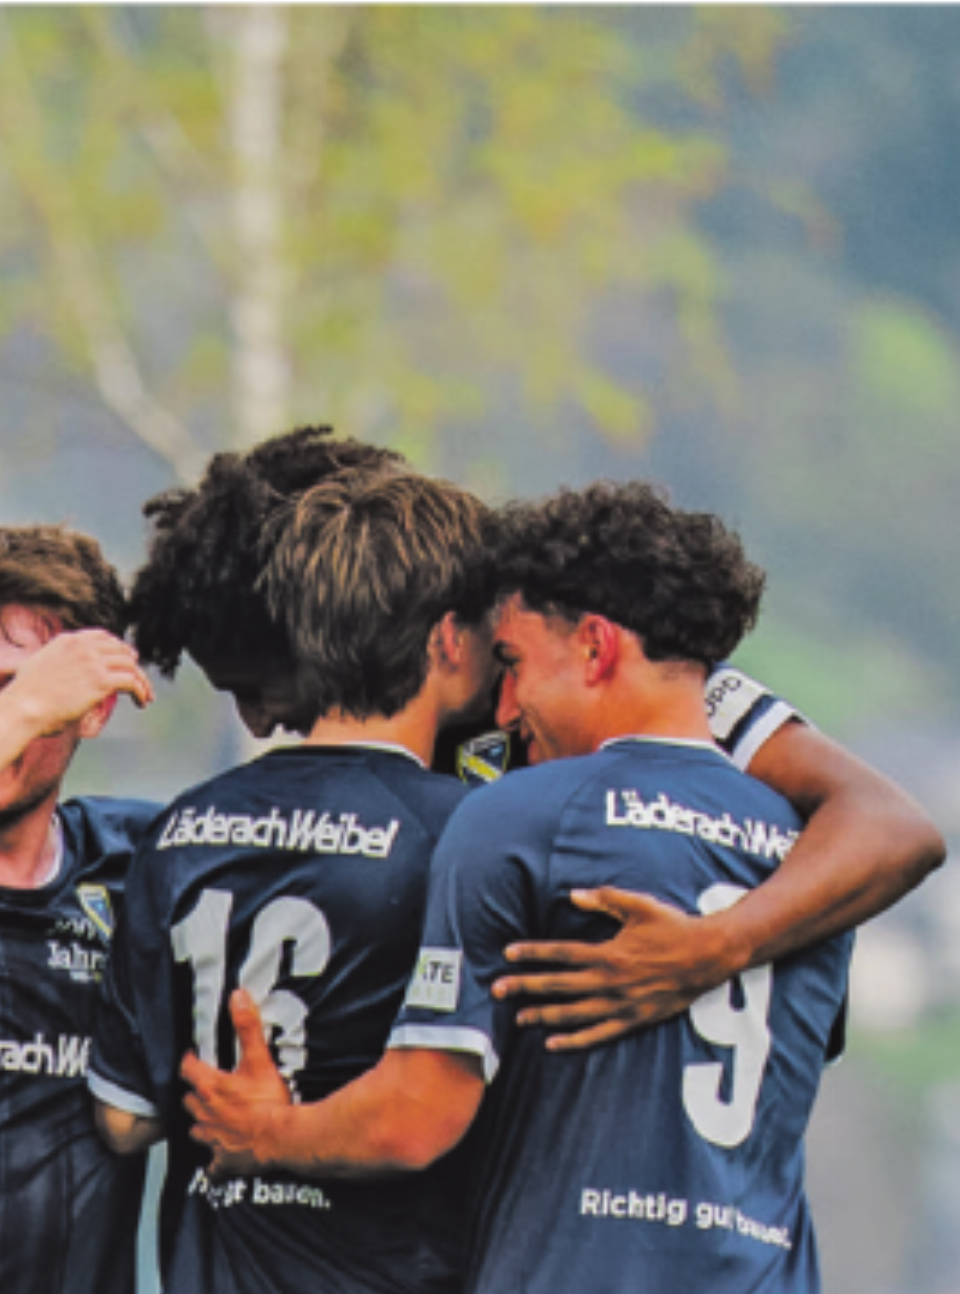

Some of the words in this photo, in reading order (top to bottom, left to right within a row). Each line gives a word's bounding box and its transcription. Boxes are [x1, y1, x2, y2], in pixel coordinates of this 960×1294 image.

[170, 888, 332, 1105] 16
[682, 882, 773, 1148] 9
[581, 1187, 688, 1226] Richtig
